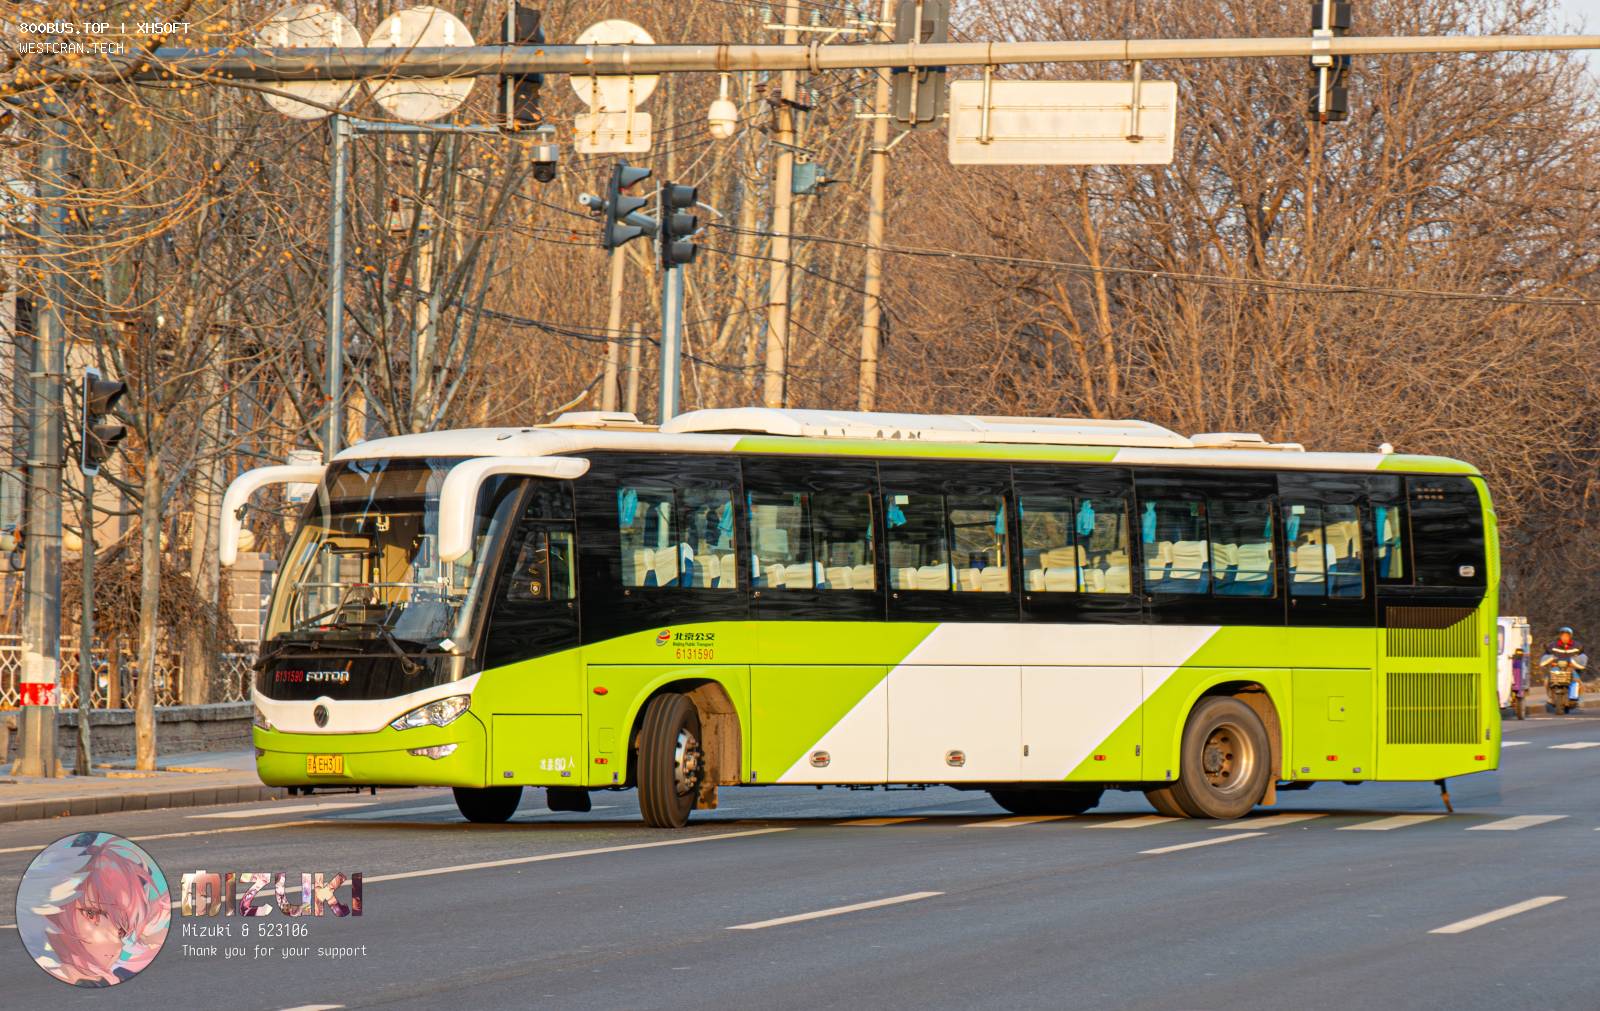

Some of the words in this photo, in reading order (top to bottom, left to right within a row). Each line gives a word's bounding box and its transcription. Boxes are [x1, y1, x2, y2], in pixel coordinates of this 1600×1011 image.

[673, 632, 715, 641] 北京公交
[676, 648, 714, 660] 6131590
[275, 670, 304, 682] 6131590
[306, 671, 349, 682] FOTON
